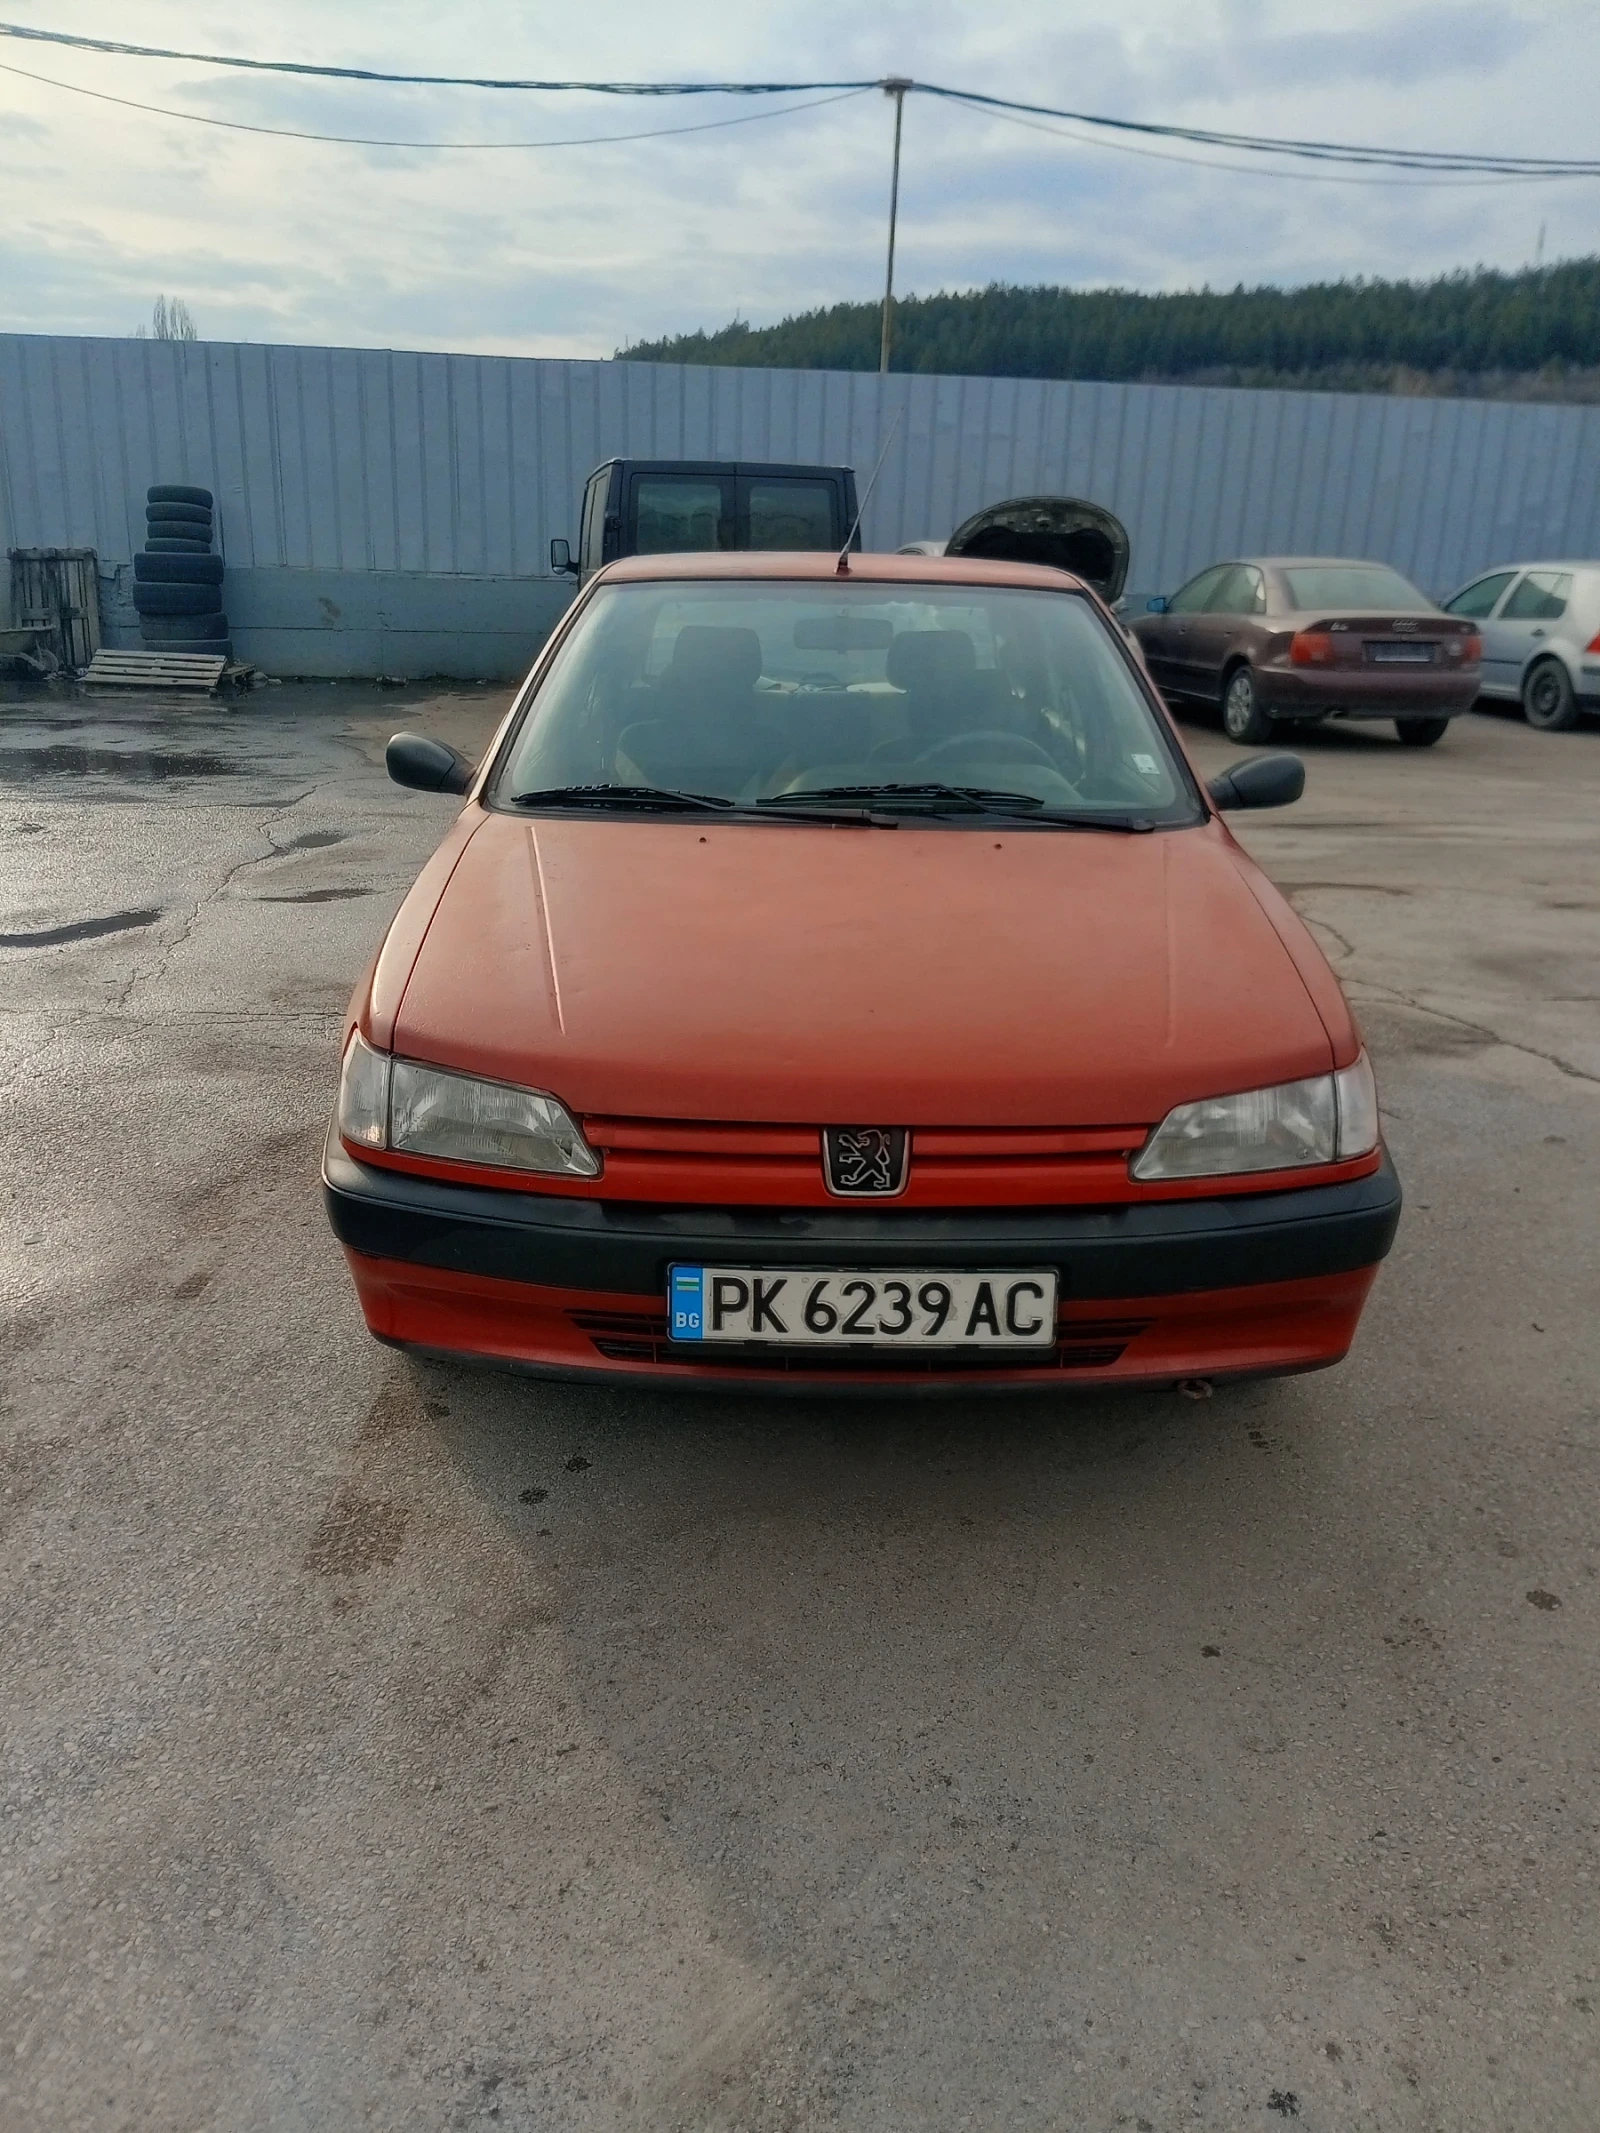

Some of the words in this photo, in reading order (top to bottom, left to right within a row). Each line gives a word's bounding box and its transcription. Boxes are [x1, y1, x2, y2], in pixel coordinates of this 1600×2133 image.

[674, 1312, 701, 1329] BG
[711, 1276, 789, 1334] PK
[804, 1280, 953, 1336] 6239
[964, 1281, 1044, 1336] AC
